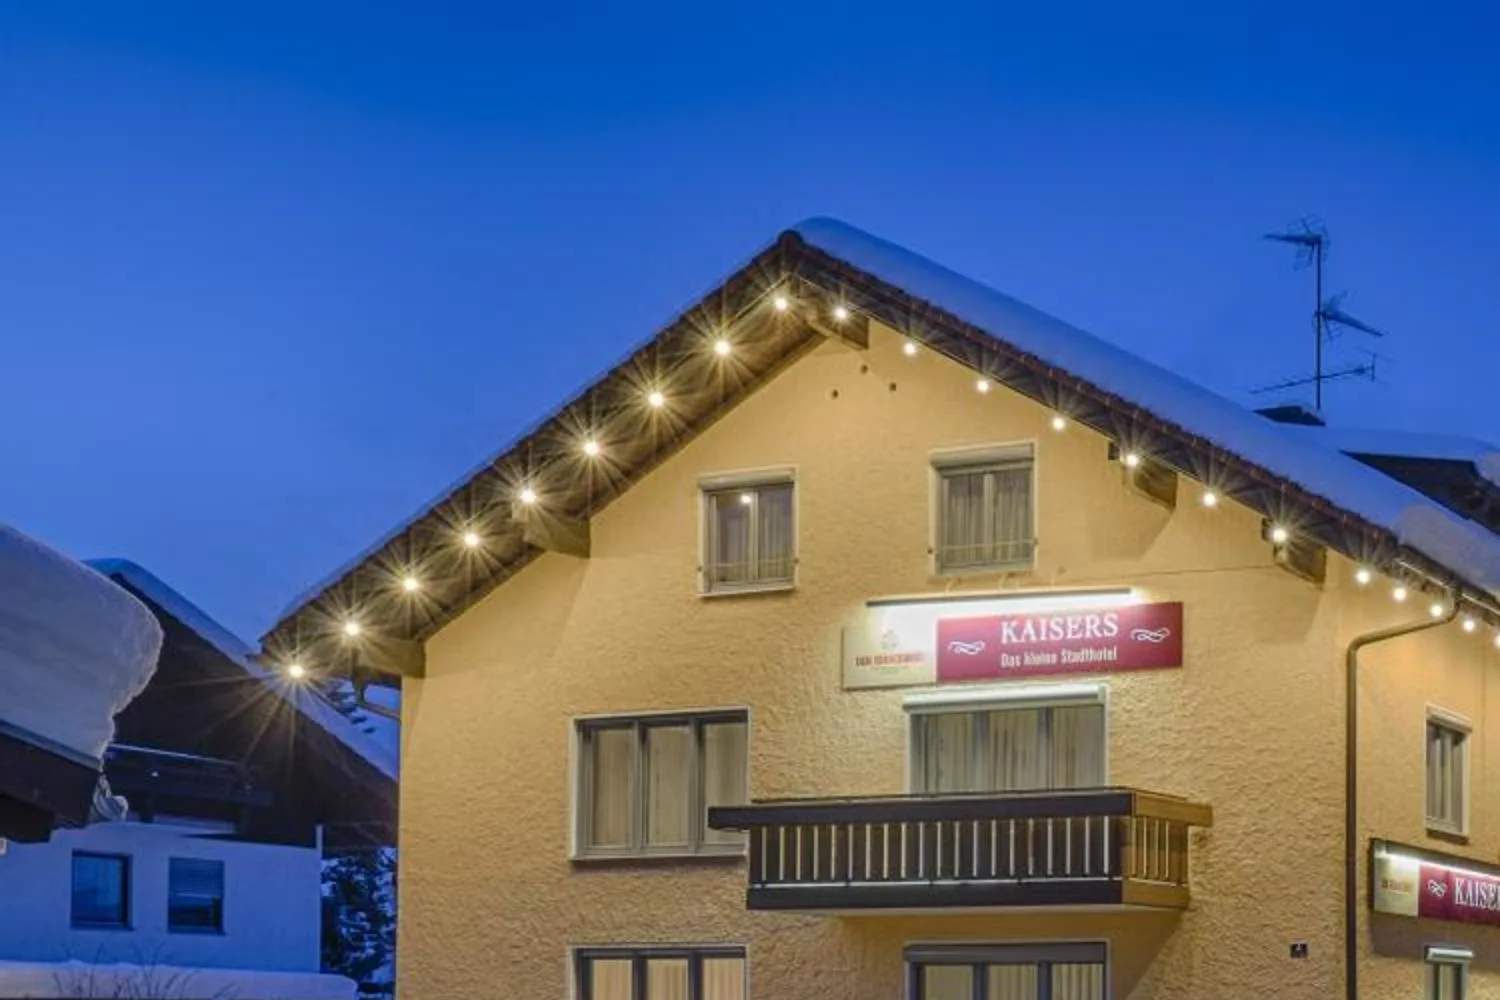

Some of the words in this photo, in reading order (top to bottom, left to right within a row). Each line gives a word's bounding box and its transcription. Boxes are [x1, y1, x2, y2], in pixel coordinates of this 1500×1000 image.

[1001, 614, 1119, 645] KAISERS
[1001, 652, 1021, 669] Das
[1061, 646, 1118, 664] Stadthotel
